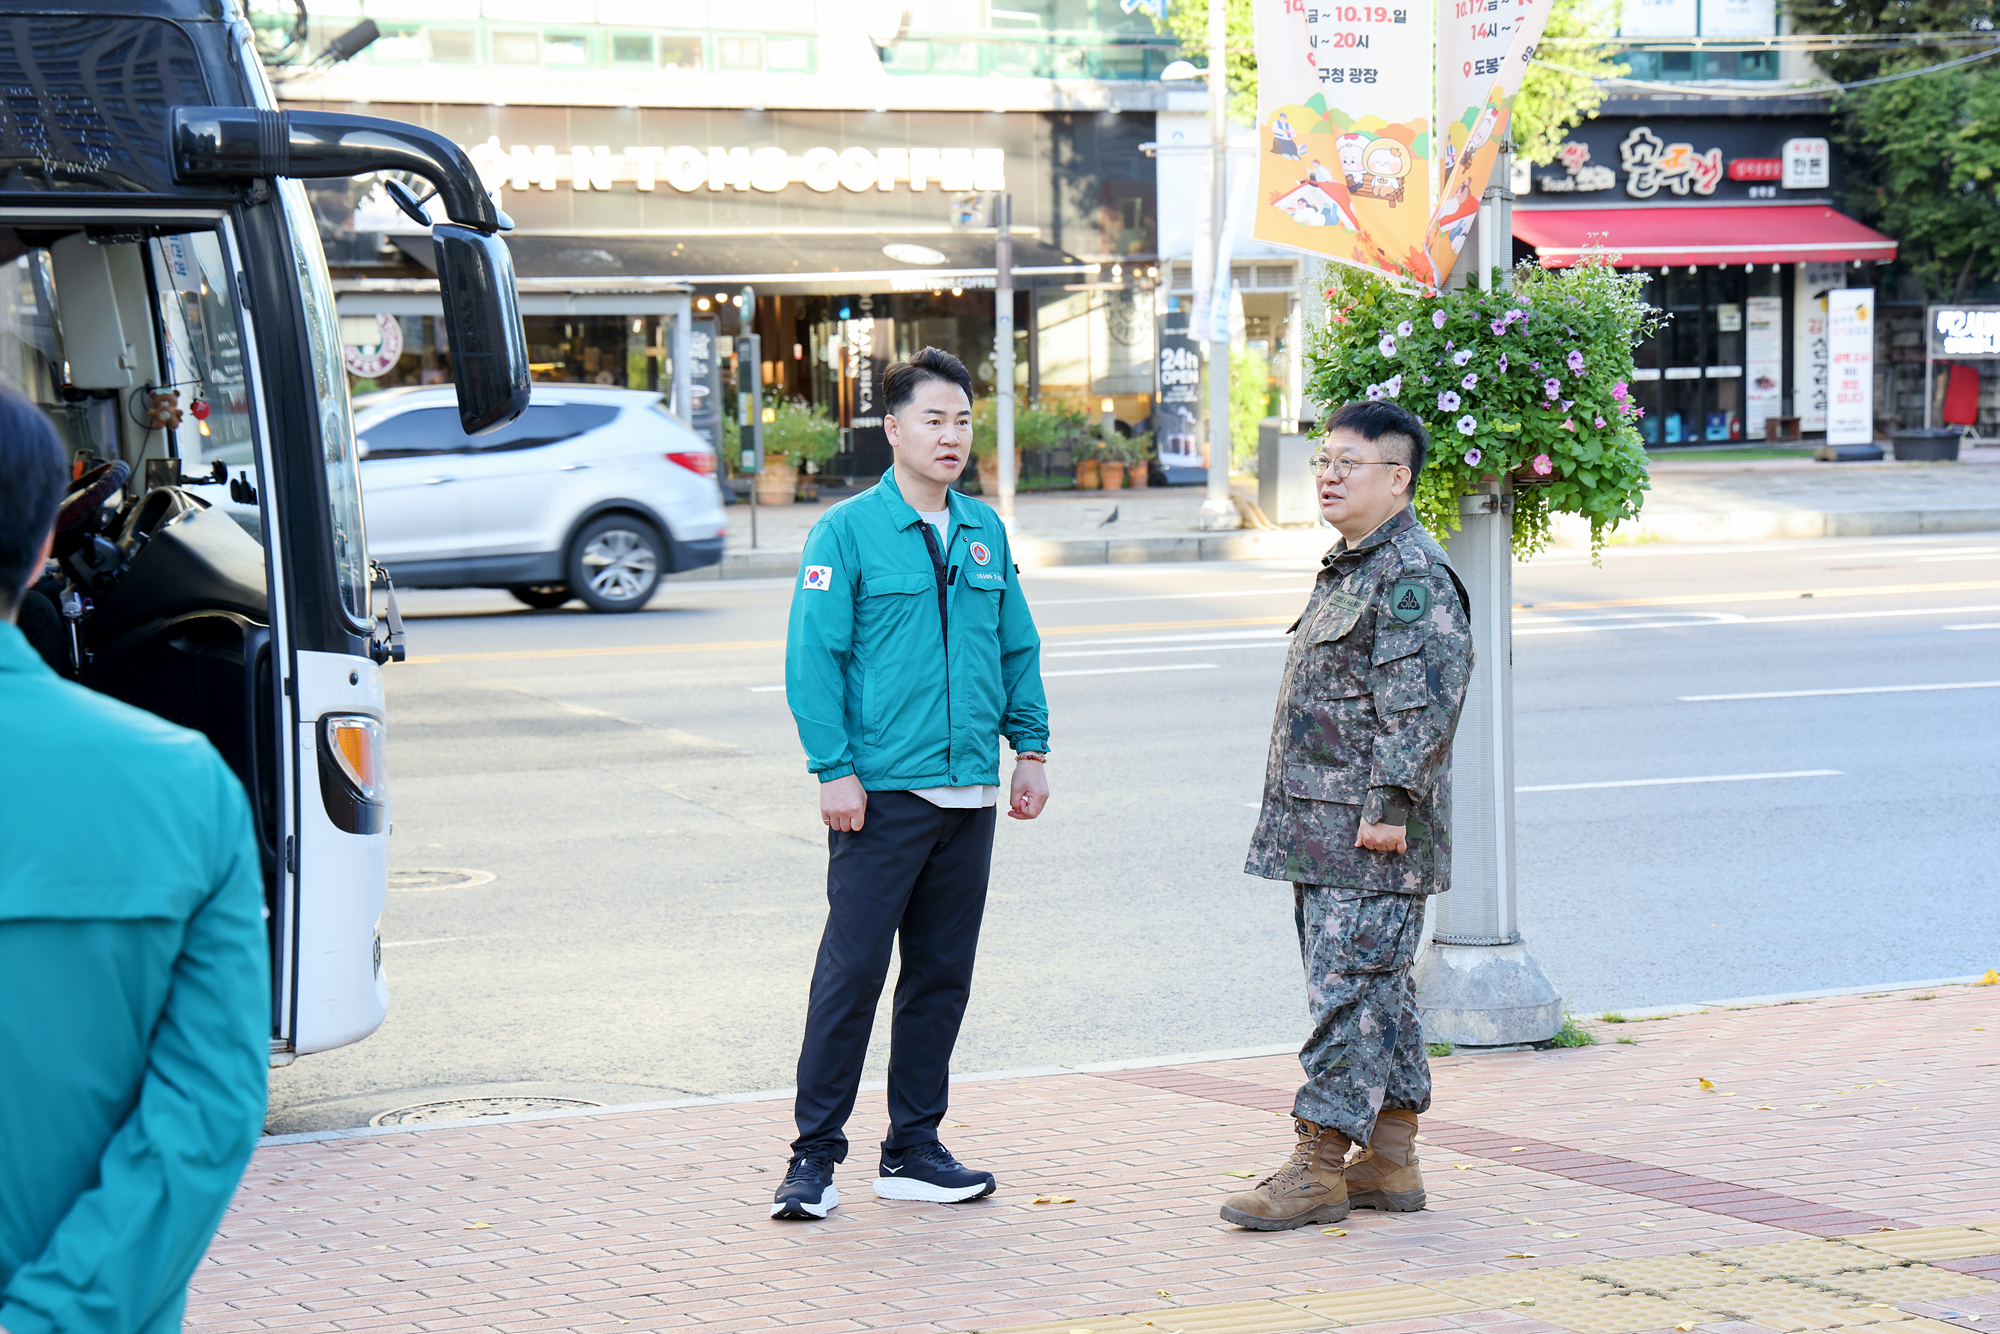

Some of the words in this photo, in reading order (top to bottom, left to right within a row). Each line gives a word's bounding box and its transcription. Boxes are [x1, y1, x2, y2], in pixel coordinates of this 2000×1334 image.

[1335, 6, 1407, 24] 10.19.일
[1333, 32, 1369, 49] 20시
[1471, 22, 1498, 41] 14시
[1475, 56, 1506, 76] 도봉
[1349, 68, 1379, 84] 광장
[458, 138, 557, 191] OM
[624, 145, 789, 192] TOMS
[802, 146, 1006, 192] COFFEE
[1160, 346, 1199, 371] 24h
[1160, 369, 1200, 386] OPEN
